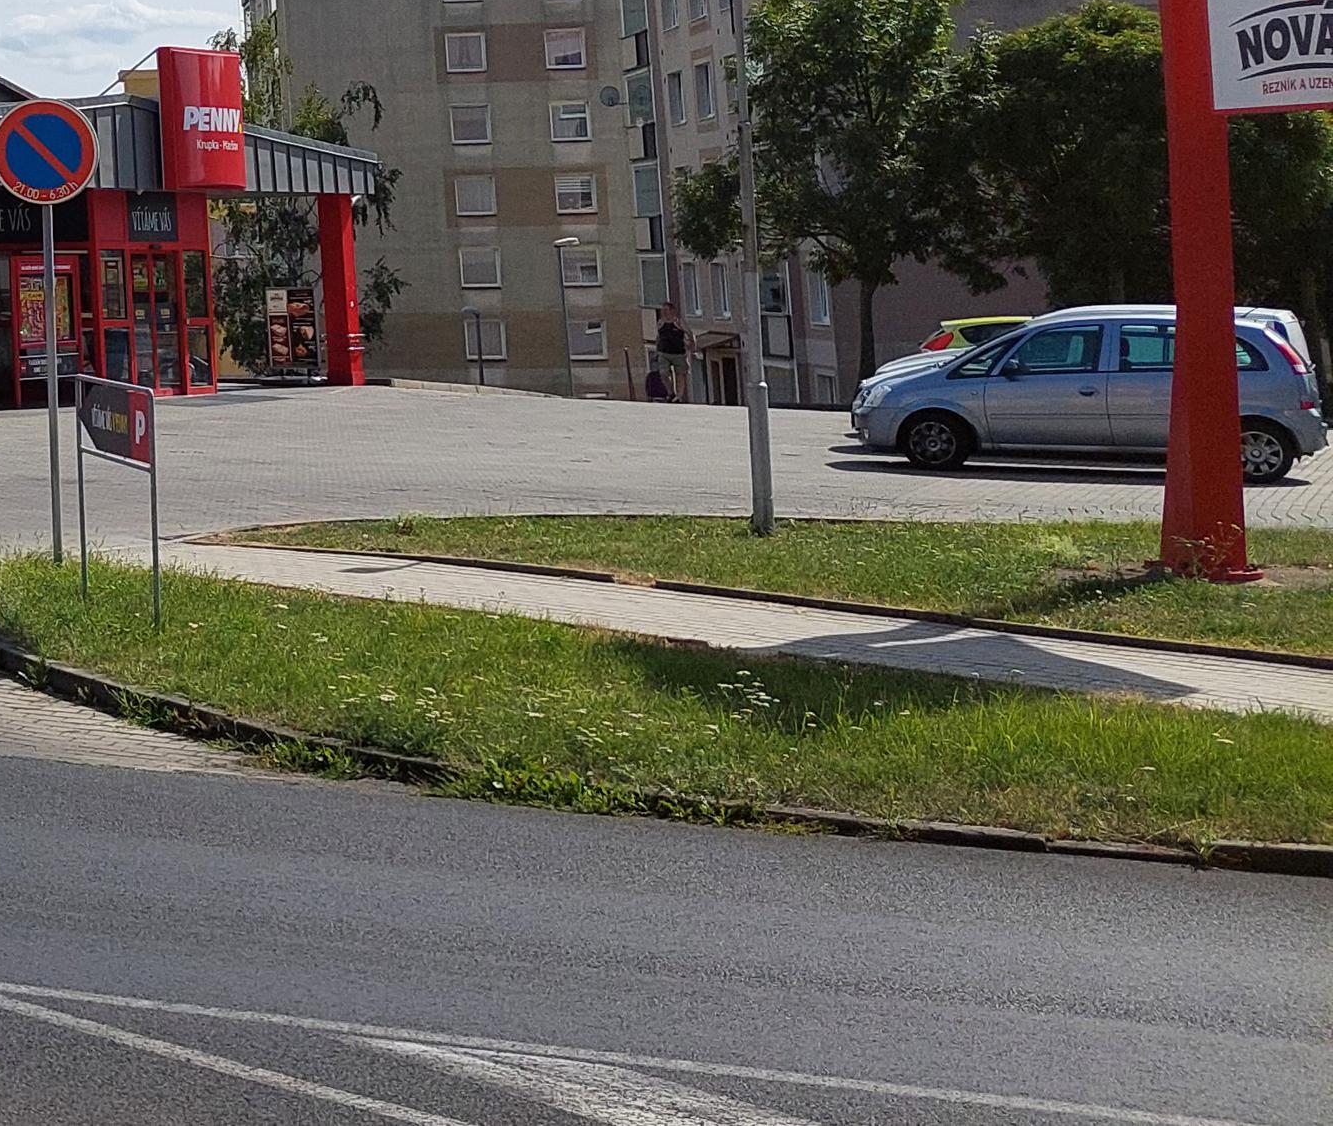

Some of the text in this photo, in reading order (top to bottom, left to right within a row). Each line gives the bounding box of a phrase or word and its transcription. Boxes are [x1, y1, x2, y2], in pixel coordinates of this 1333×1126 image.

[13, 181, 40, 200] 21.00
[49, 184, 70, 200] 6.30
[7, 203, 32, 232] VÁS
